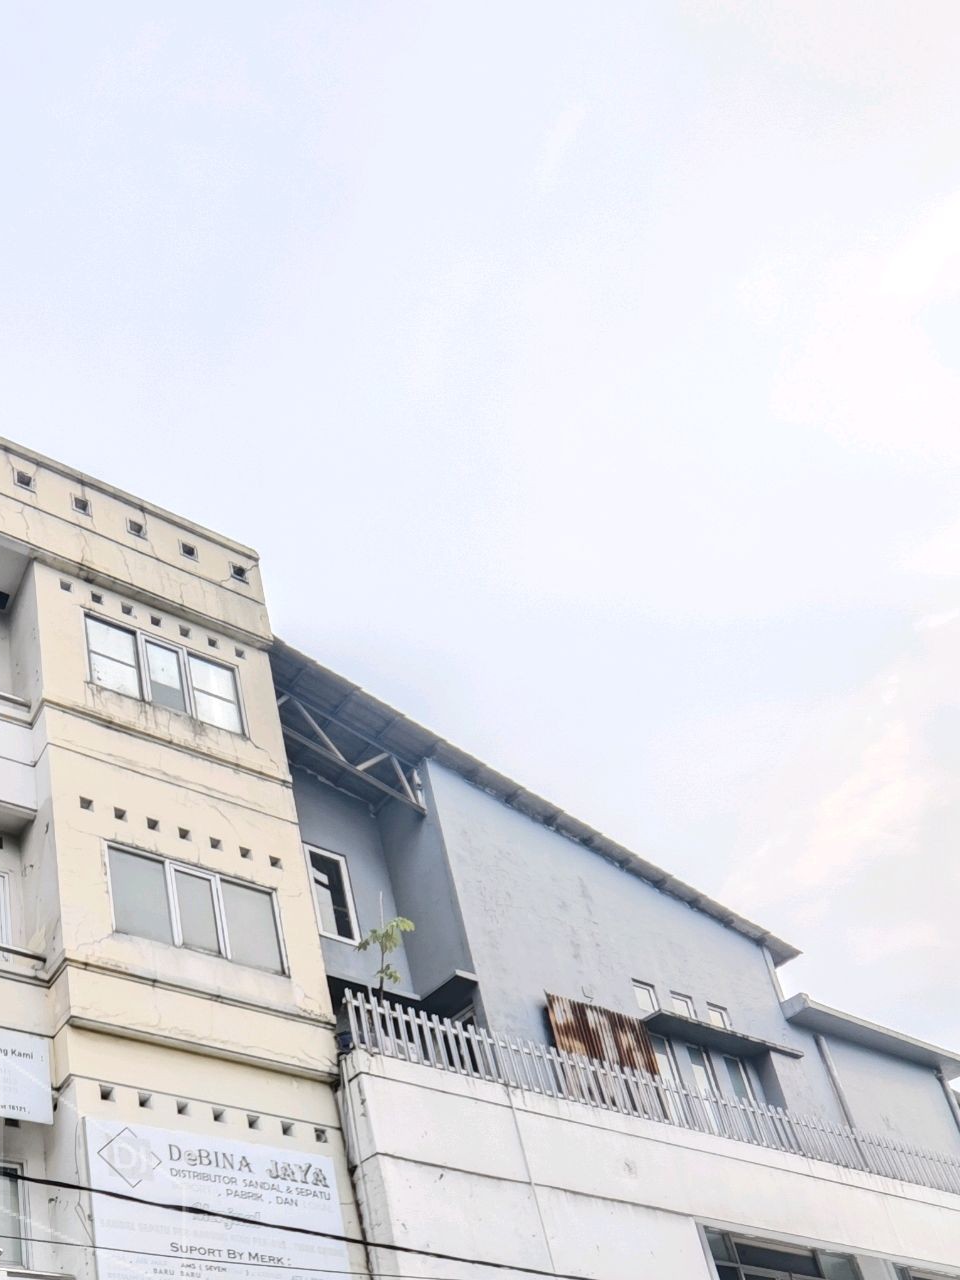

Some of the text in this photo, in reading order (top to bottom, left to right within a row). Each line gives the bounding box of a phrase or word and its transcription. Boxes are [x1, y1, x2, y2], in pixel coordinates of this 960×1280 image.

[169, 1168, 238, 1186] DISTRIBUTOR
[242, 1178, 282, 1194] SANDAL
[295, 1187, 331, 1201] SEPATU
[265, 1159, 330, 1189] JAYA
[276, 1196, 298, 1207] DAN
